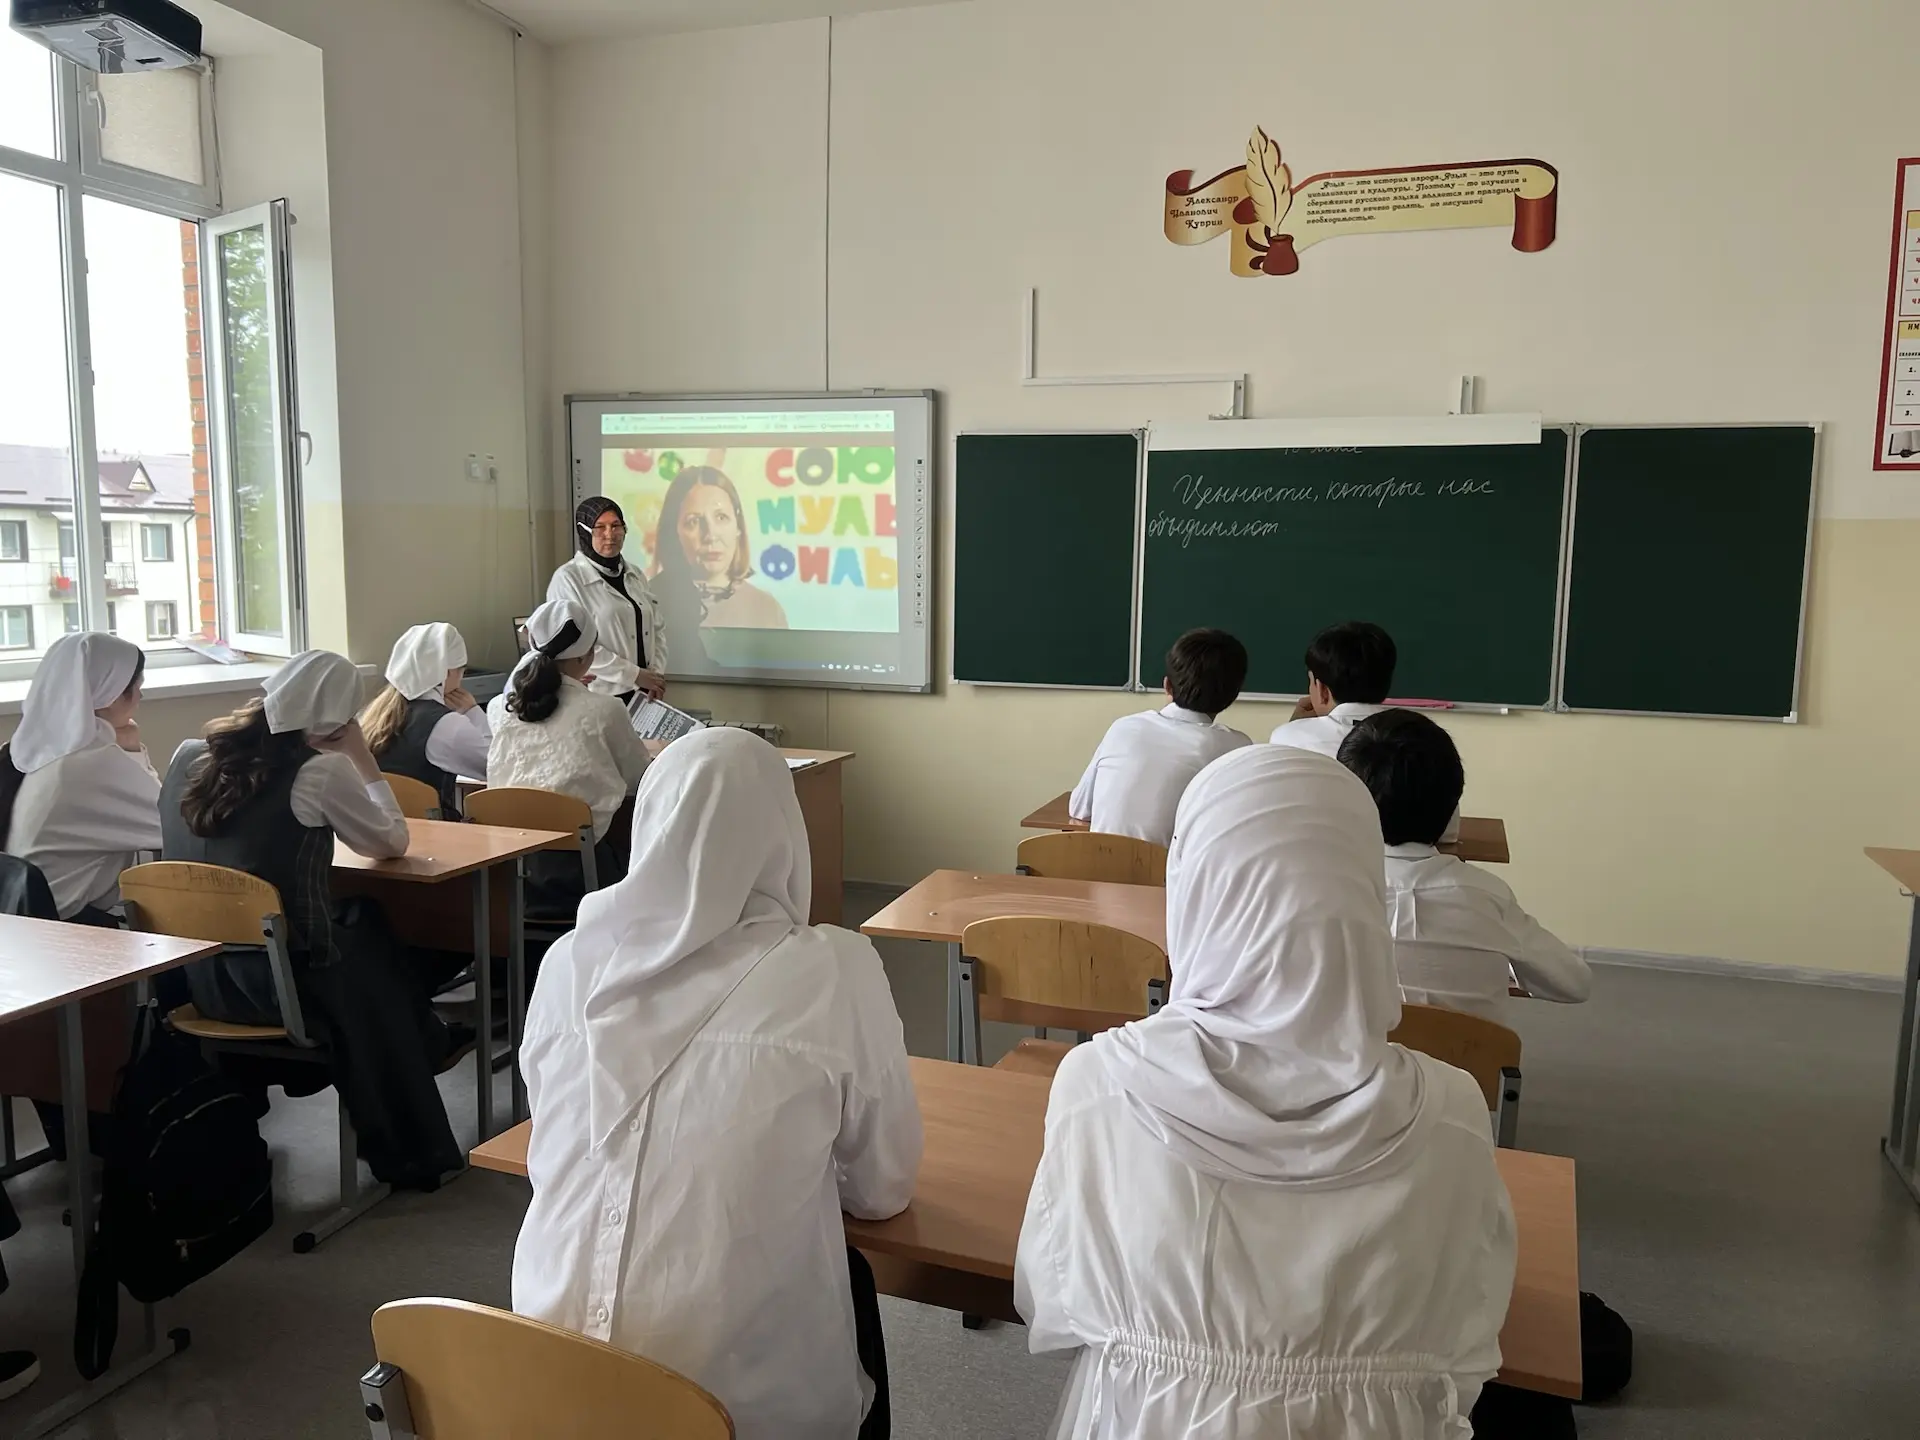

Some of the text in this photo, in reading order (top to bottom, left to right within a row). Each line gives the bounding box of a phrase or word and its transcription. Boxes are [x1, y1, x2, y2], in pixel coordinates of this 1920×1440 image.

[1307, 189, 1358, 198] цивилизации
[1367, 185, 1413, 194] культуры.
[1415, 182, 1456, 192] Поэтому
[1481, 178, 1520, 186] изучение
[1320, 181, 1346, 190] Язык
[1373, 176, 1408, 184] история
[1441, 172, 1467, 181] Язык
[1497, 169, 1519, 177] путь
[1185, 196, 1239, 206] Александр
[1307, 198, 1353, 207] сбережение
[1355, 195, 1390, 204] русского
[1392, 193, 1419, 201] языка
[1422, 191, 1462, 199] является
[1477, 186, 1521, 195] праздным
[1307, 208, 1347, 216] занятием
[1442, 197, 1483, 207] насущной
[1170, 208, 1218, 219] Иванович
[1306, 215, 1376, 225] необходимостью.
[1185, 219, 1223, 229] Куприн
[765, 447, 895, 487] СОЮ
[1173, 474, 1495, 510] Ценности, которые нас
[1148, 511, 1279, 548] объединяют
[760, 544, 898, 590] ФИЛЬ
